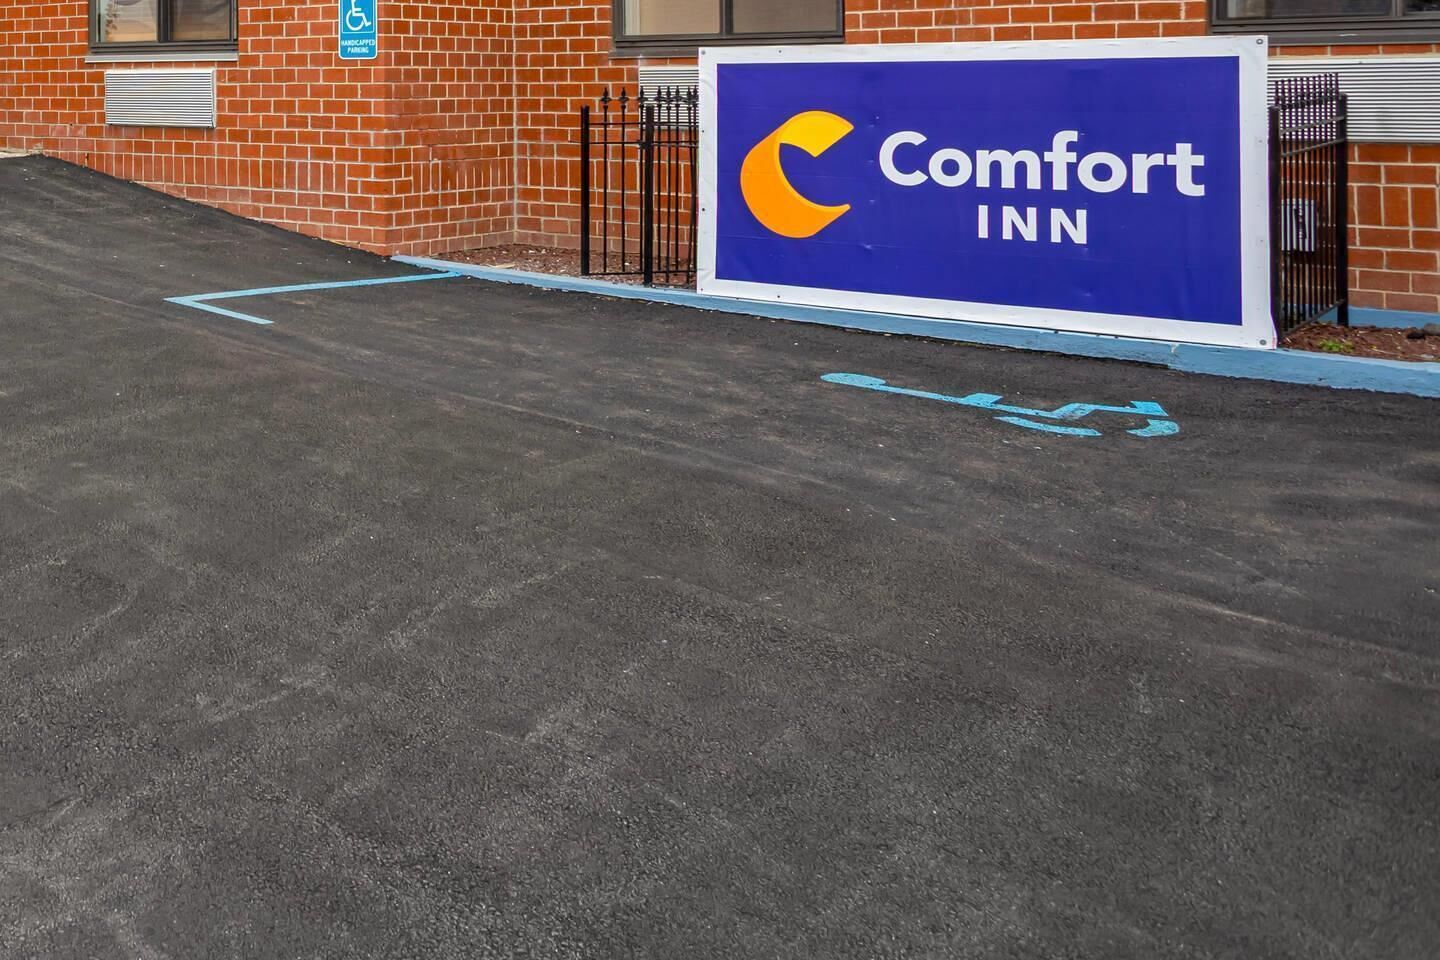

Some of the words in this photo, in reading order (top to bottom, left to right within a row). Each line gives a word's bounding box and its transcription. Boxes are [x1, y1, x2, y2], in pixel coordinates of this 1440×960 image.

[347, 46, 369, 54] PARKING
[878, 129, 1206, 197] Comfort
[977, 204, 1088, 245] INN
